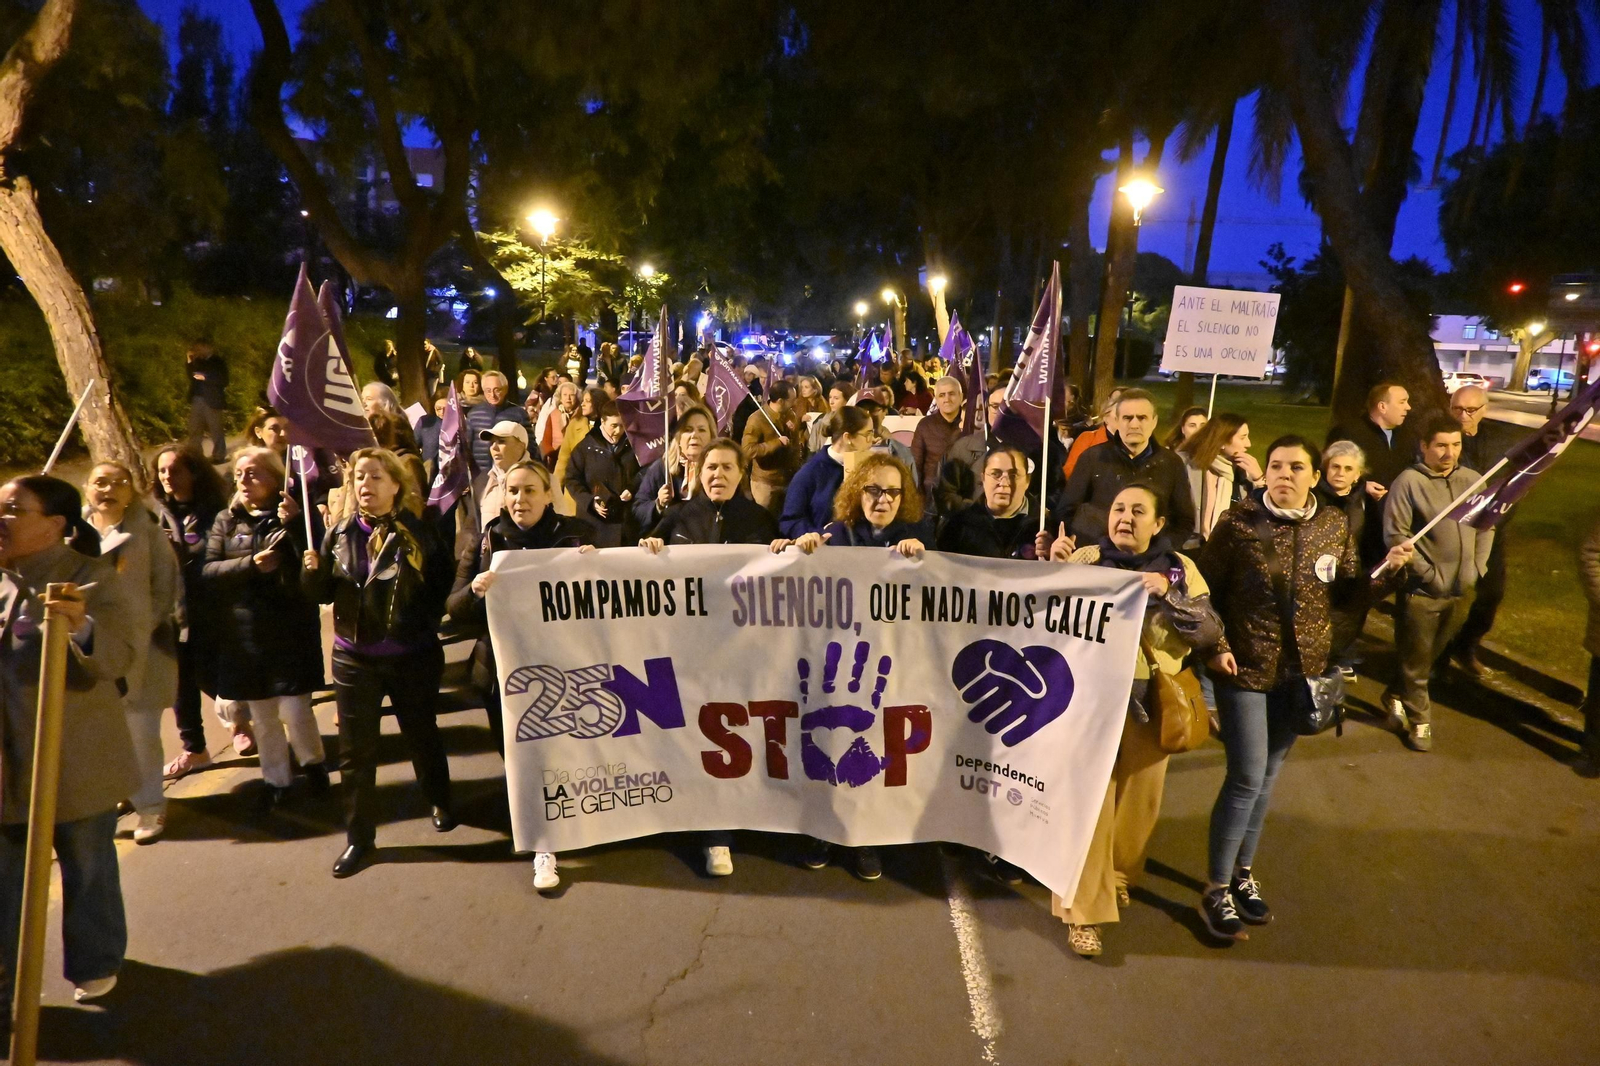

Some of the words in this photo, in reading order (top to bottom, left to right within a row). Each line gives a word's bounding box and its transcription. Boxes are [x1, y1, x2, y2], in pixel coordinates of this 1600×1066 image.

[1178, 296, 1206, 310] ANTE
[1211, 299, 1222, 313] EL
[1231, 300, 1276, 318] MALTRATO
[1177, 320, 1190, 333] EL
[1197, 321, 1240, 335] SILENCIO
[1245, 325, 1259, 336] NO
[1175, 345, 1188, 358] ES
[1194, 346, 1213, 359] UNA
[539, 578, 677, 622] ROMPAMOS
[685, 577, 708, 617] EL
[731, 576, 862, 637] SILENCIO,
[869, 583, 911, 623] QUE
[921, 586, 977, 624] NADA
[987, 590, 1036, 629] NOS
[1045, 595, 1114, 644] CALLE
[505, 656, 686, 743] 25N
[541, 767, 571, 786] Día
[574, 761, 627, 780] contra
[543, 784, 568, 801] LA
[571, 770, 671, 797] VIOLENCIA
[955, 754, 1045, 792] Dependencia
[959, 774, 1002, 799] UGT
[545, 798, 576, 821] DE
[581, 785, 673, 815] GENERO
